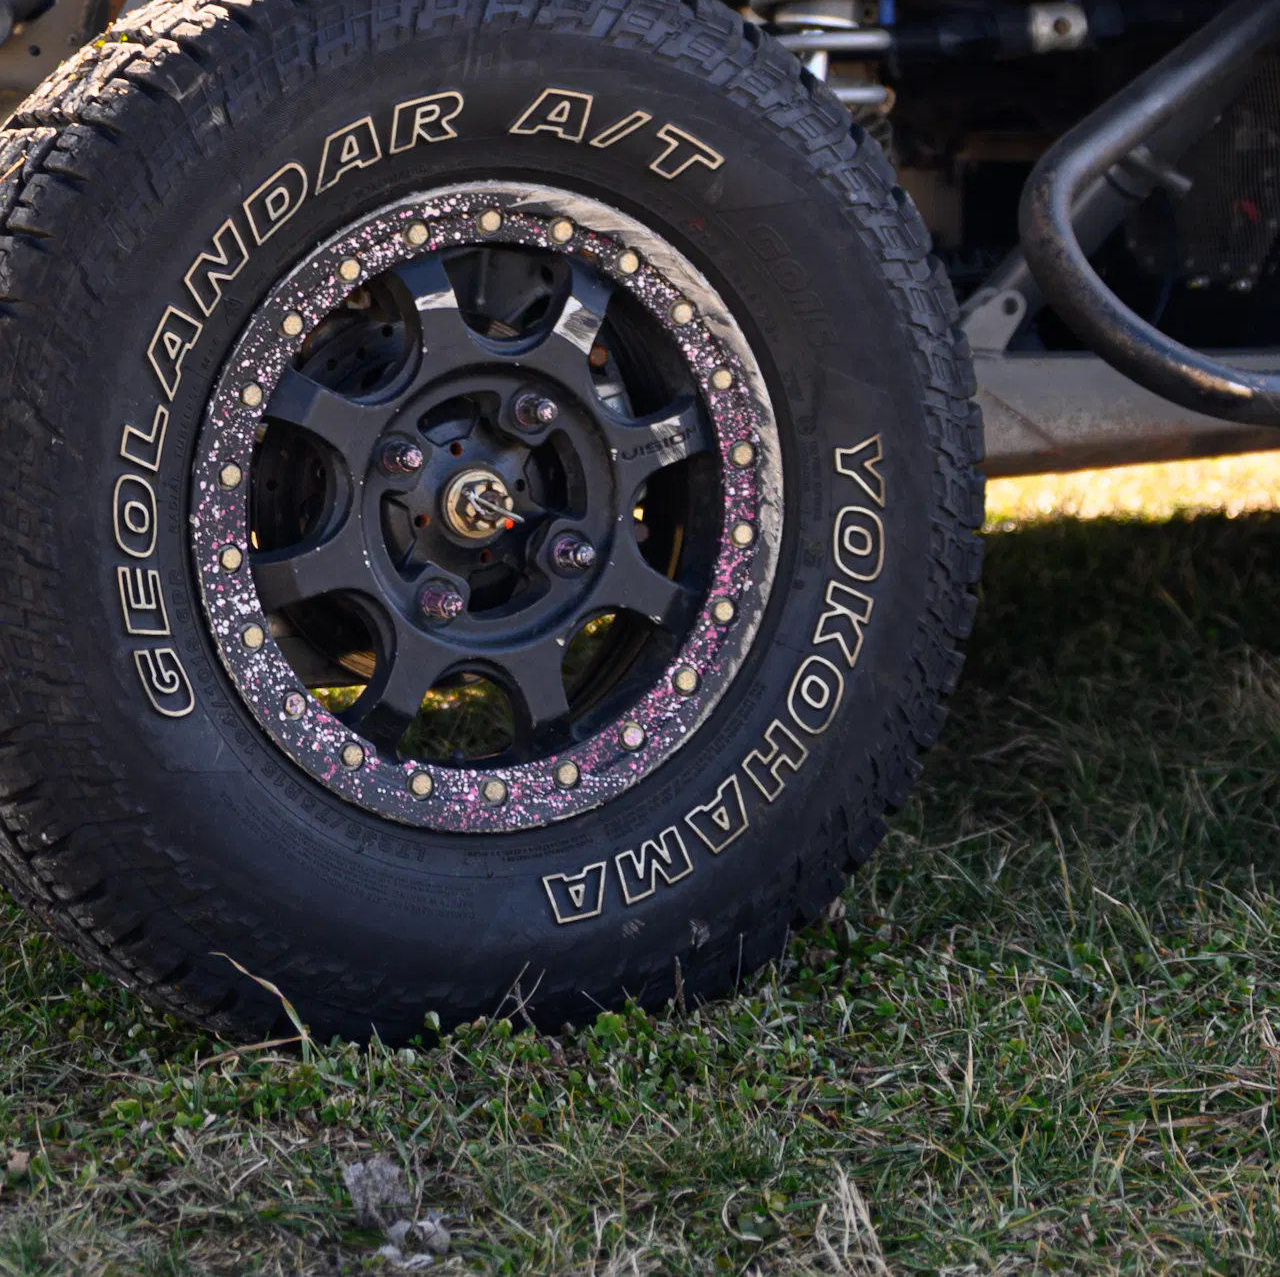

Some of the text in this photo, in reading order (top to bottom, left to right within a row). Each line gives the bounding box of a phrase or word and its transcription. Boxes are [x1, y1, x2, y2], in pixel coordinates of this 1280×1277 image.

[113, 90, 464, 718] GEOLANDAR
[509, 87, 726, 180] A/T
[621, 426, 697, 461] VISION
[542, 432, 888, 925] YOKOHAMA
